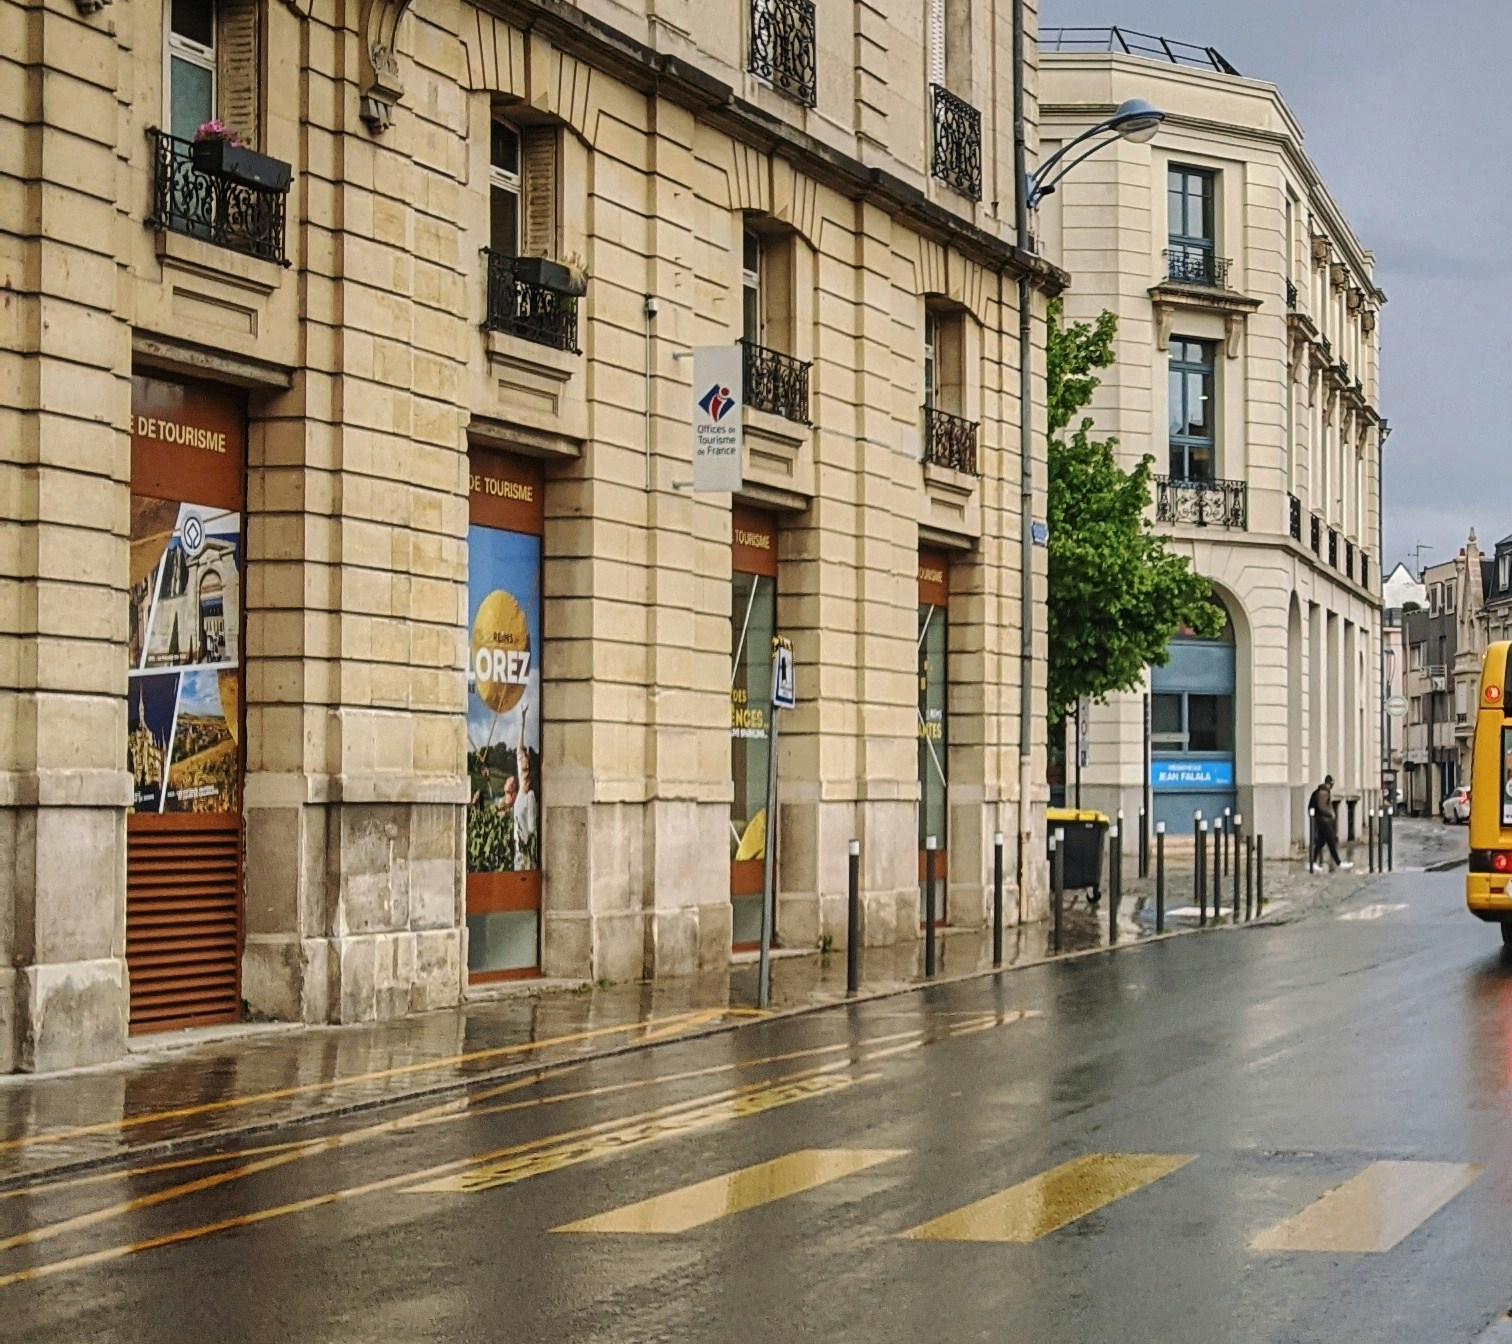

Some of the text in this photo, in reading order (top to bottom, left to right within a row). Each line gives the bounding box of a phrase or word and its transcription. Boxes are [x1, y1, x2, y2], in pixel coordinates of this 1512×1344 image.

[138, 416, 157, 439] DE
[157, 420, 226, 453] TOURISME
[697, 424, 726, 435] Offices
[698, 435, 736, 445] Tourisme
[707, 446, 736, 456] France
[484, 477, 533, 503] TOURISME
[734, 529, 770, 550] TOURISME
